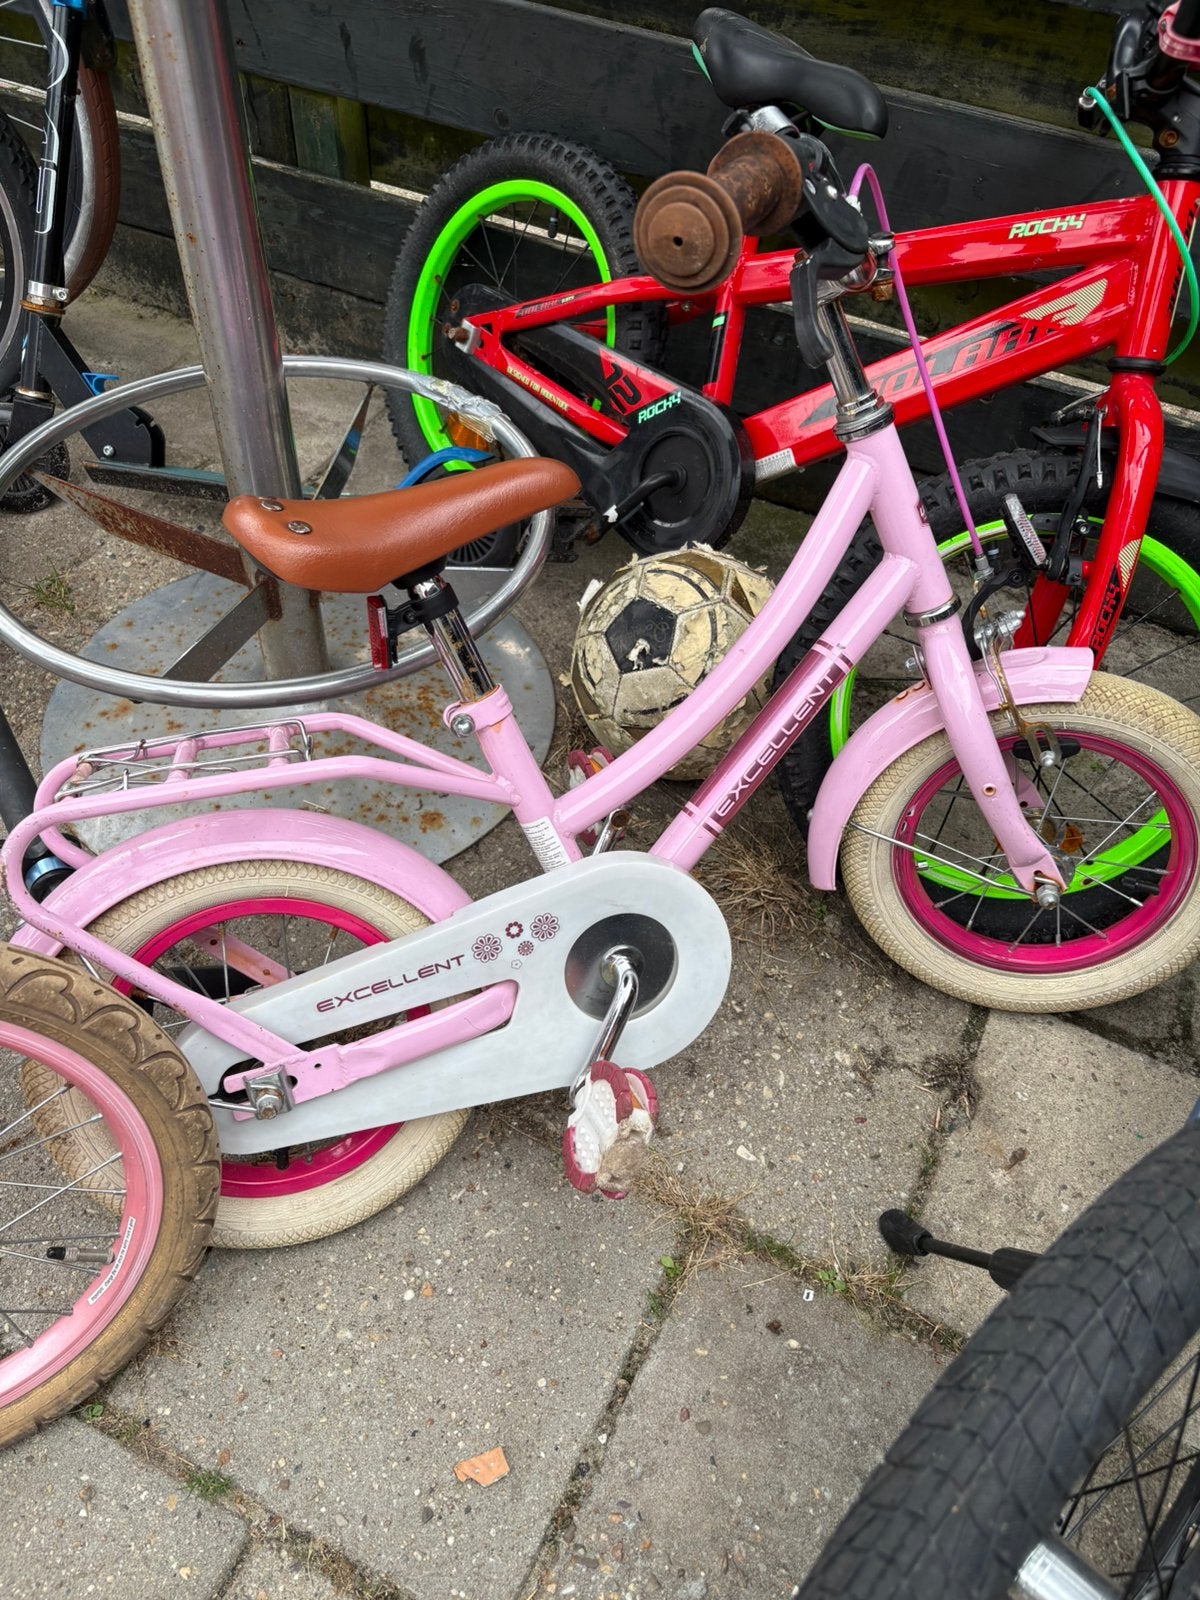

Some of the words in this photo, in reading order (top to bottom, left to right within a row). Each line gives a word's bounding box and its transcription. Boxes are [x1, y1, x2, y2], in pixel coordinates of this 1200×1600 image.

[1008, 213, 1087, 239] ROCKY
[638, 391, 681, 424] ROCKY
[715, 669, 834, 817] EXCELLENT
[316, 954, 465, 1013] EXCELLENT
